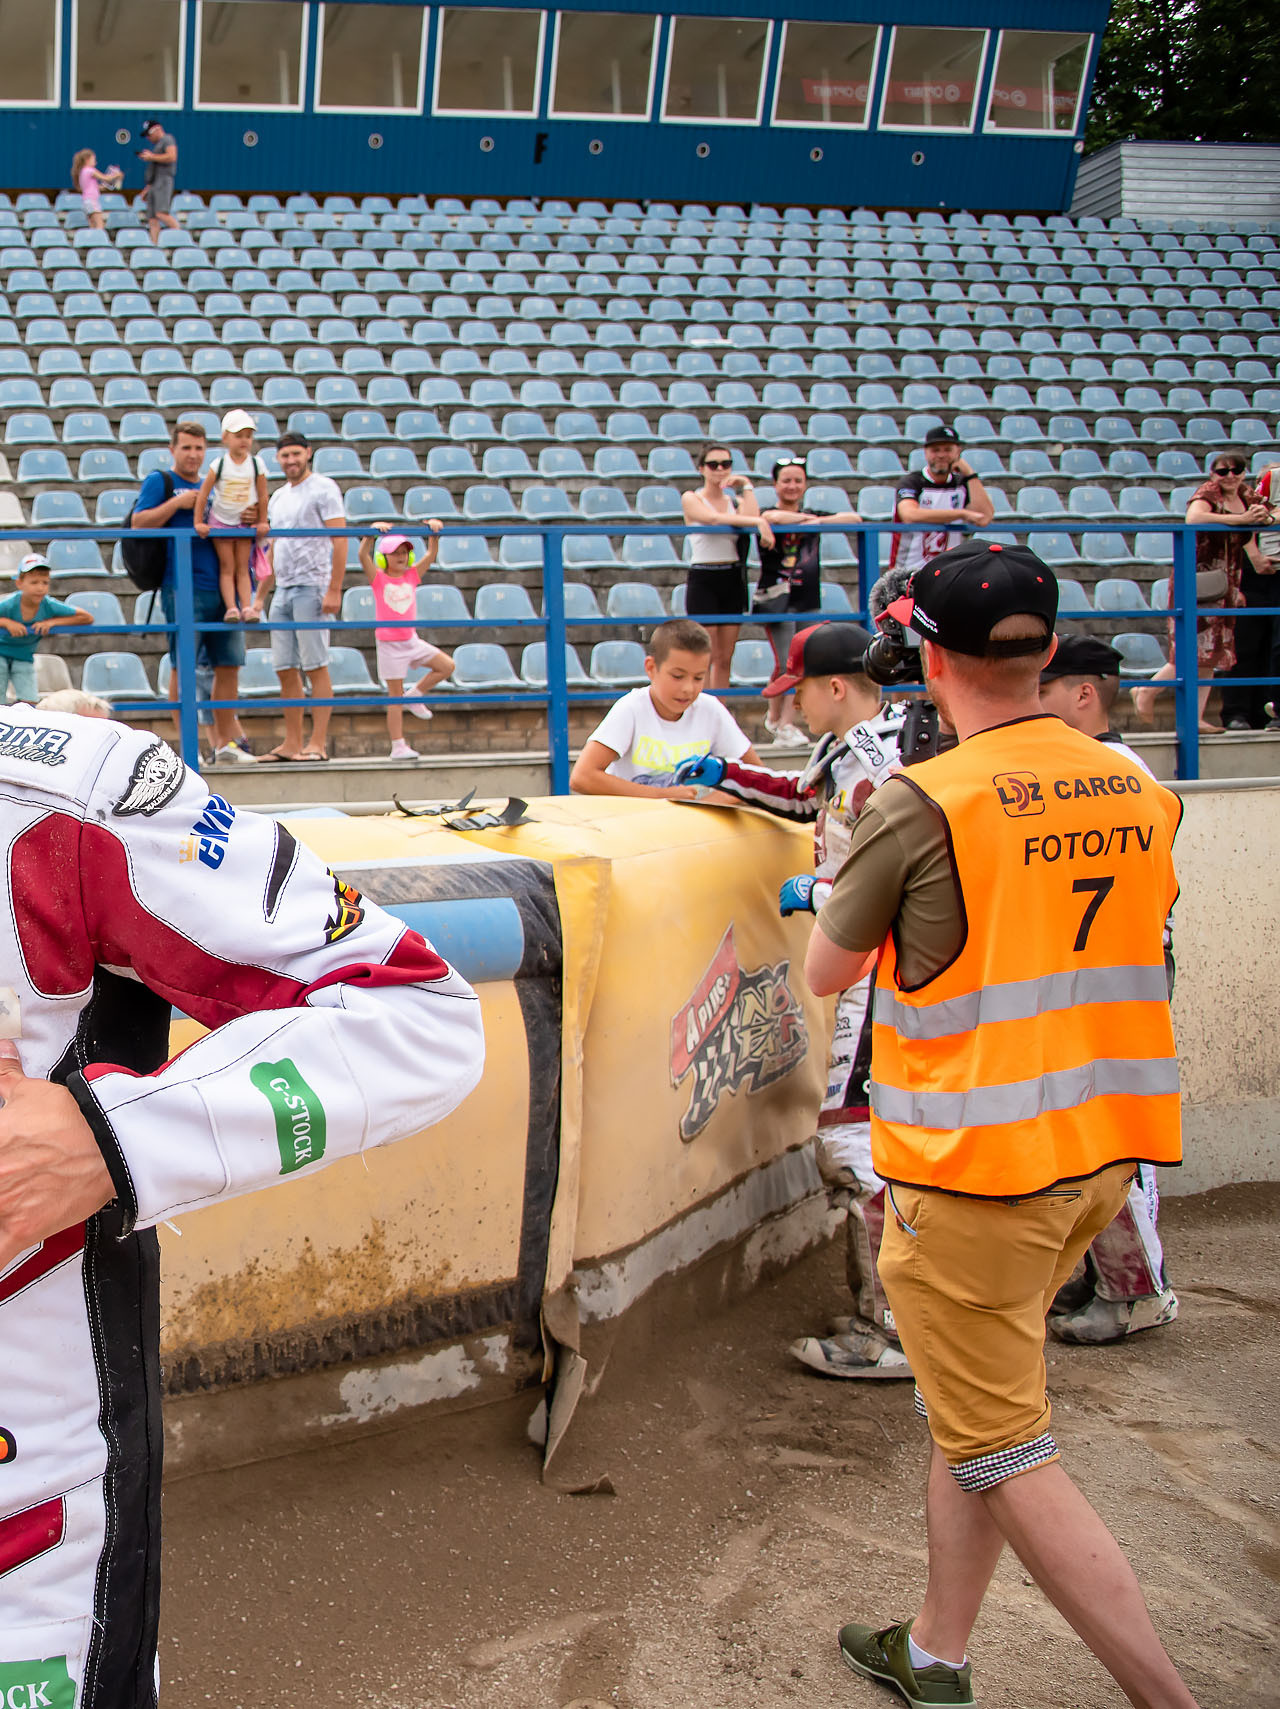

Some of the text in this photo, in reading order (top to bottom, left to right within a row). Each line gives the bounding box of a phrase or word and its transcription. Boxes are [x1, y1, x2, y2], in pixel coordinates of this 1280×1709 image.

[1053, 775, 1142, 800] CARGO
[1024, 825, 1155, 867] FOTO/TV
[1071, 875, 1116, 952] 7
[269, 1077, 312, 1165] G-STOCK
